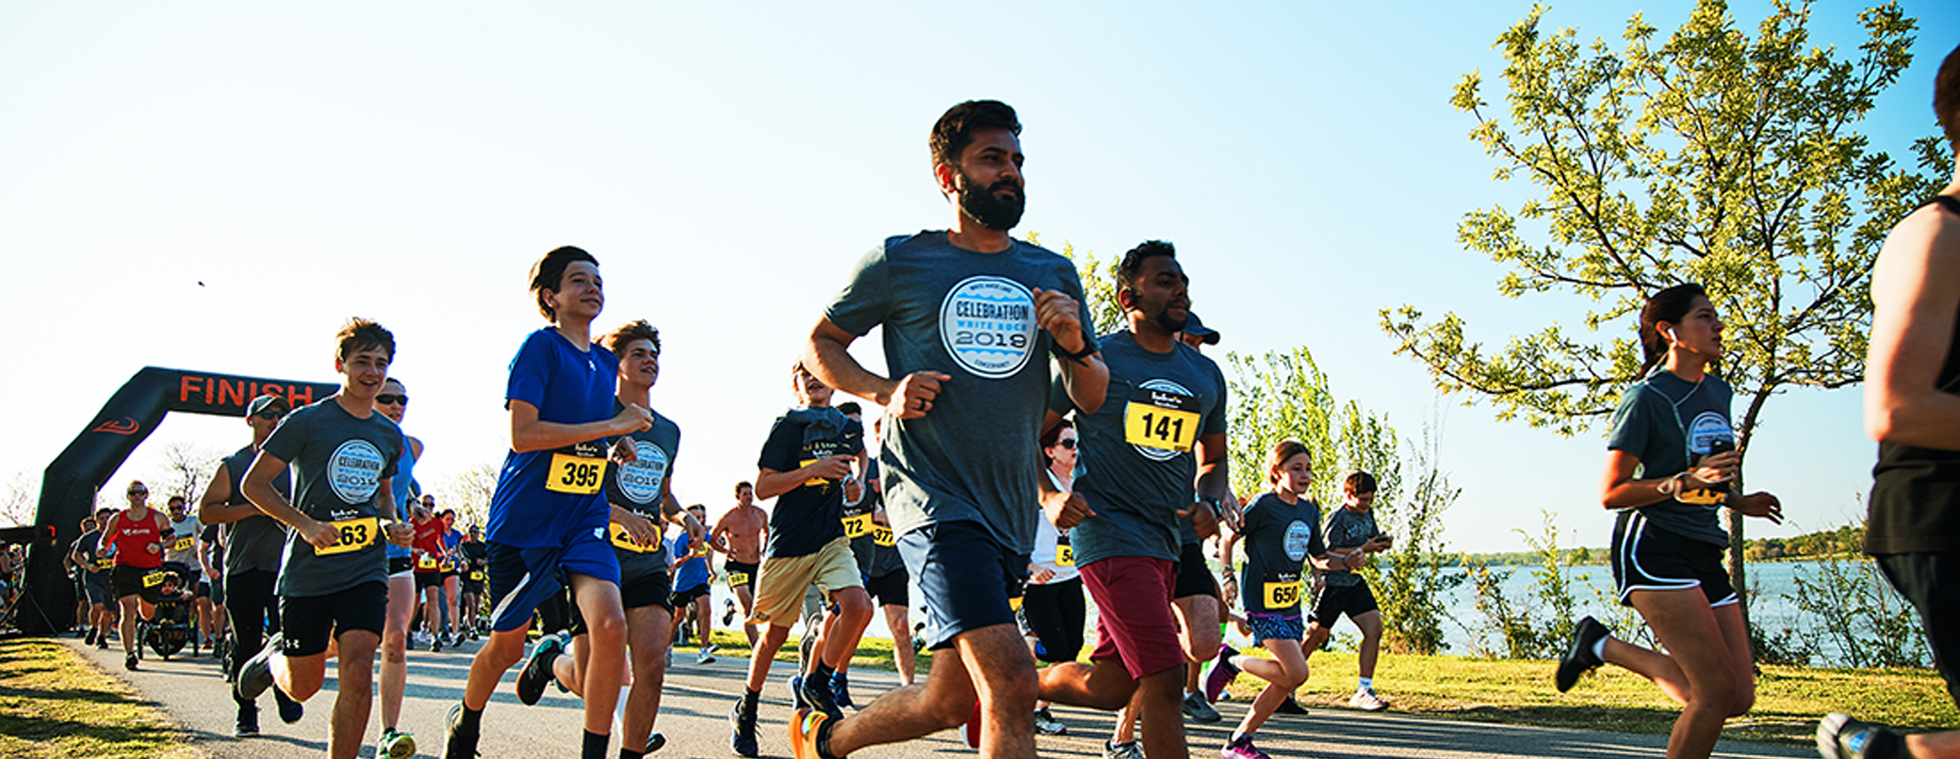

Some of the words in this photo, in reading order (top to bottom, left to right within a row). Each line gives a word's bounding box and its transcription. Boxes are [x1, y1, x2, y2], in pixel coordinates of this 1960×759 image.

[956, 301, 1029, 321] CELEBRATION
[957, 320, 993, 330] WHITE
[998, 323, 1027, 332] ROCK
[956, 330, 1027, 349] 2019
[180, 375, 312, 409] FINISH
[1142, 412, 1184, 443] 141
[561, 462, 599, 487] 395
[331, 523, 368, 546] 63
[1273, 585, 1298, 604] 650
